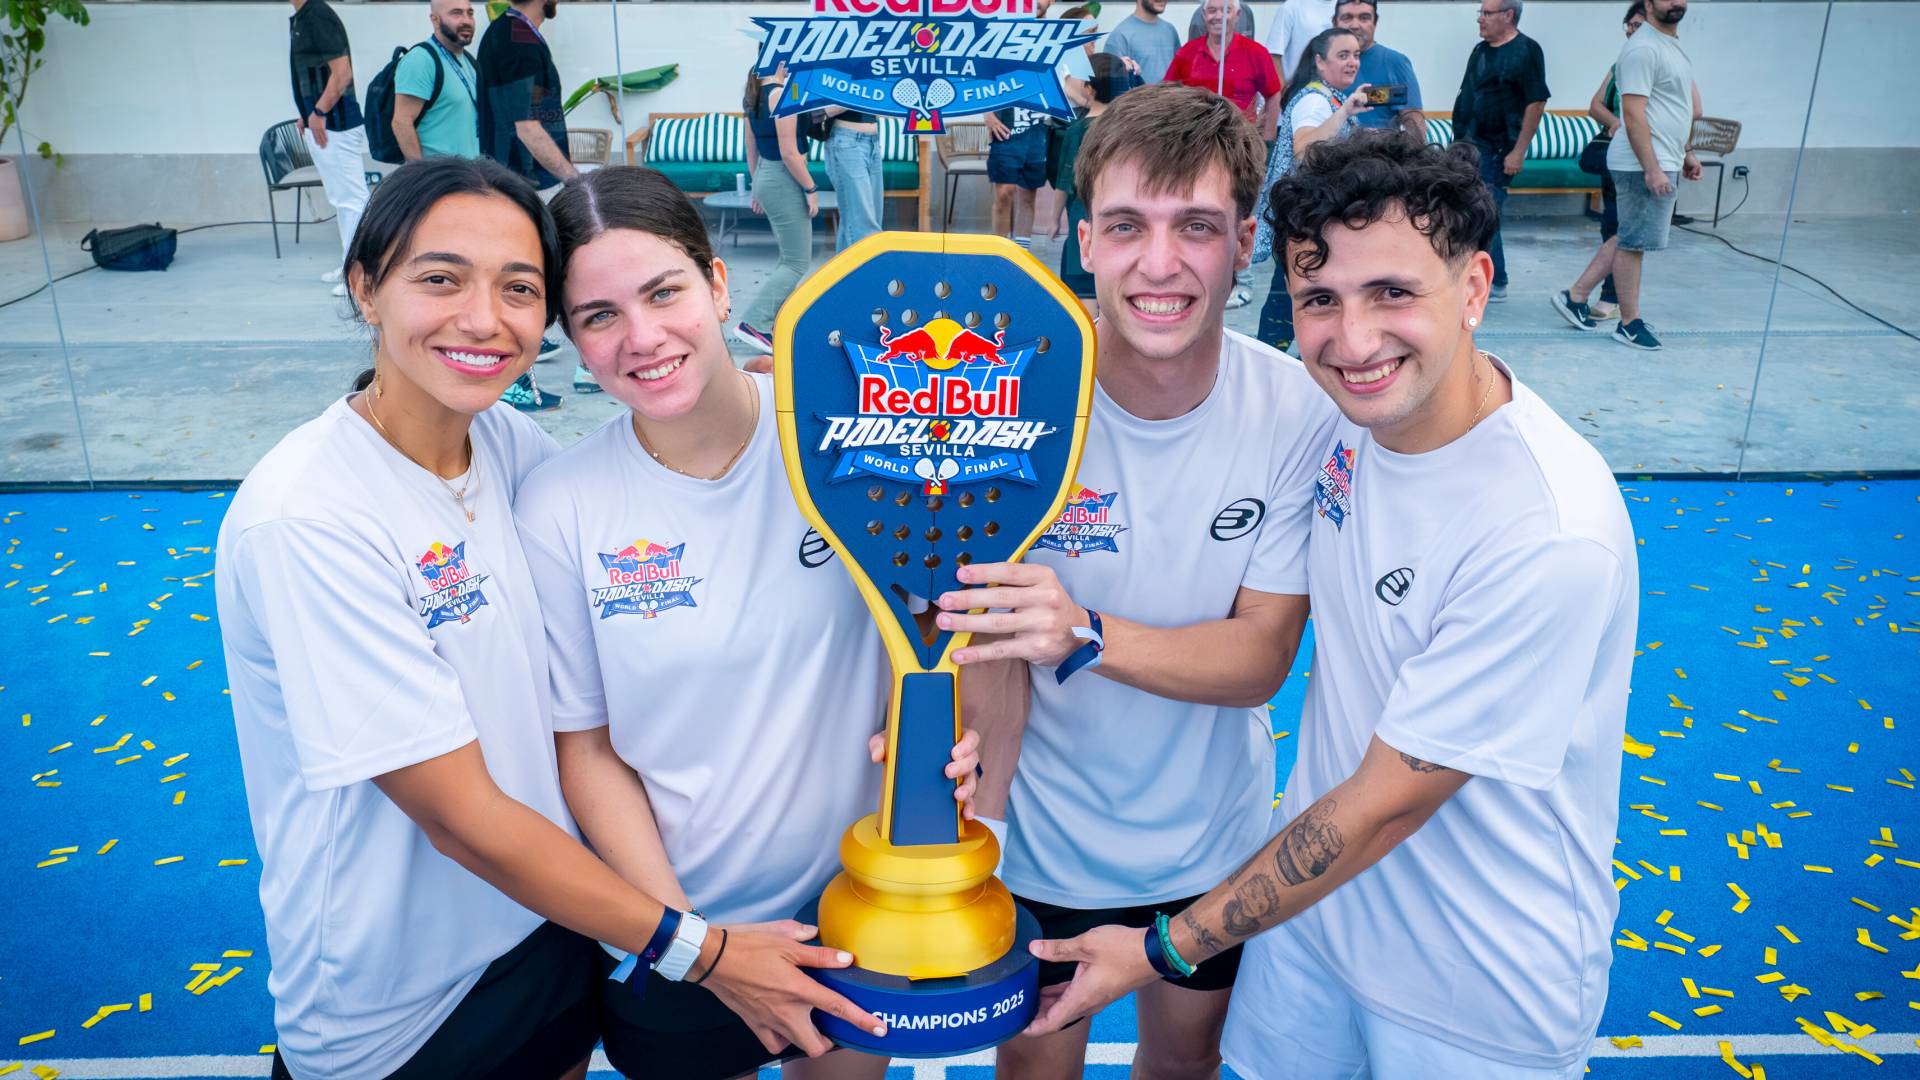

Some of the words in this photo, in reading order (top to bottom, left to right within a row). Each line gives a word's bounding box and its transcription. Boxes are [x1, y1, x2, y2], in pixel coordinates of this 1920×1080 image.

[759, 20, 912, 68] PADEL
[938, 20, 1101, 64] DASH
[871, 60, 977, 77] SEVILLA
[821, 74, 885, 102] WORLD
[963, 77, 1024, 102] FINAL
[862, 377, 939, 415] Red
[945, 378, 1019, 416] Bull
[818, 417, 930, 451] PADEL
[946, 420, 1057, 450] DASH
[900, 444, 976, 458] SEVILLA
[863, 454, 909, 475] WORLD
[964, 458, 1009, 476] FINAL
[1077, 507, 1108, 523] Bull
[1045, 525, 1070, 535] DEL
[1078, 525, 1121, 538] DASH
[1084, 541, 1104, 549] FINAL
[447, 560, 470, 584] Bull
[609, 563, 645, 586] Red
[646, 560, 681, 581] Bull
[593, 582, 643, 607] PADEL
[652, 576, 697, 594] DASH
[630, 592, 665, 603] SEVILLA
[992, 989, 1025, 1018] 2025
